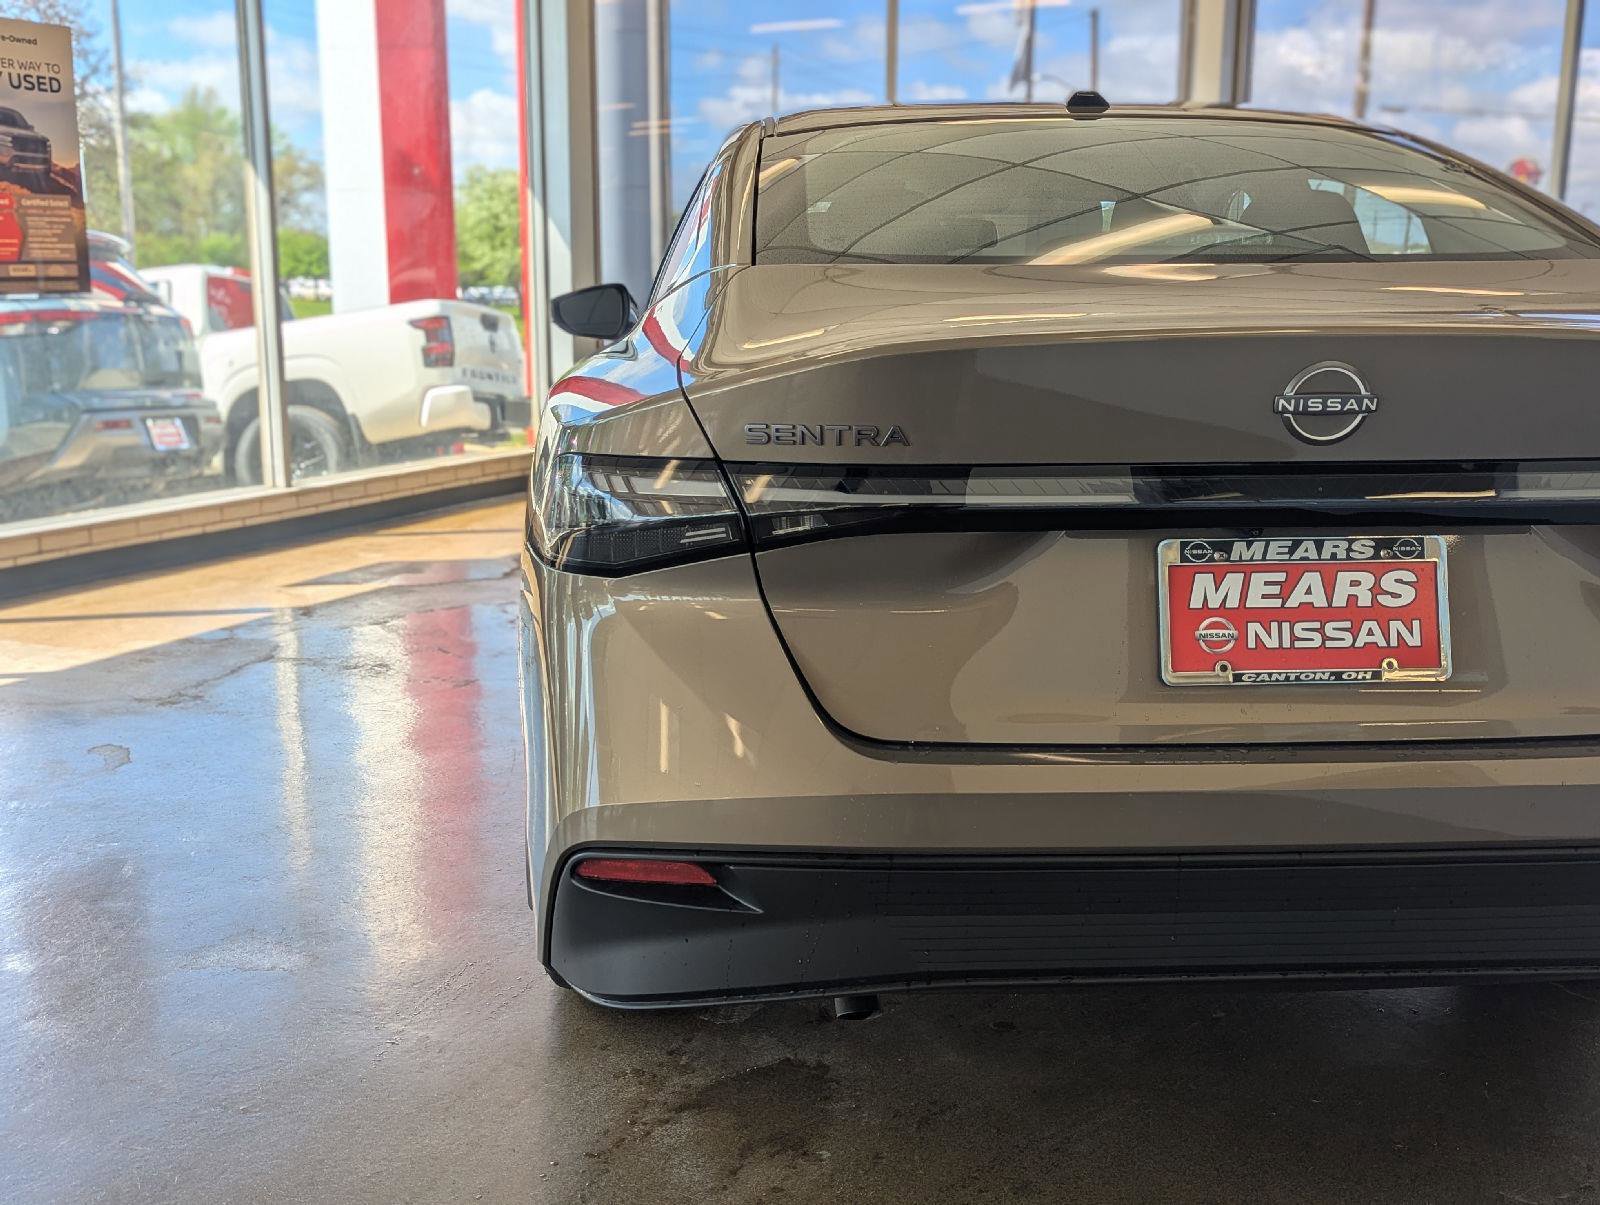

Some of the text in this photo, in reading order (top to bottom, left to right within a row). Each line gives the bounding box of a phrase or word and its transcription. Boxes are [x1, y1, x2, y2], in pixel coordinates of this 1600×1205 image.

[17, 60, 41, 71] WAY
[45, 62, 61, 74] TO
[8, 72, 62, 93] USED
[1278, 398, 1378, 411] NISSAN
[744, 423, 911, 447] SENTRA
[1230, 539, 1376, 561] MEARS
[1189, 569, 1418, 609] MEARS
[1247, 619, 1422, 649] NISSAN
[1241, 671, 1373, 682] CANTON, OH
